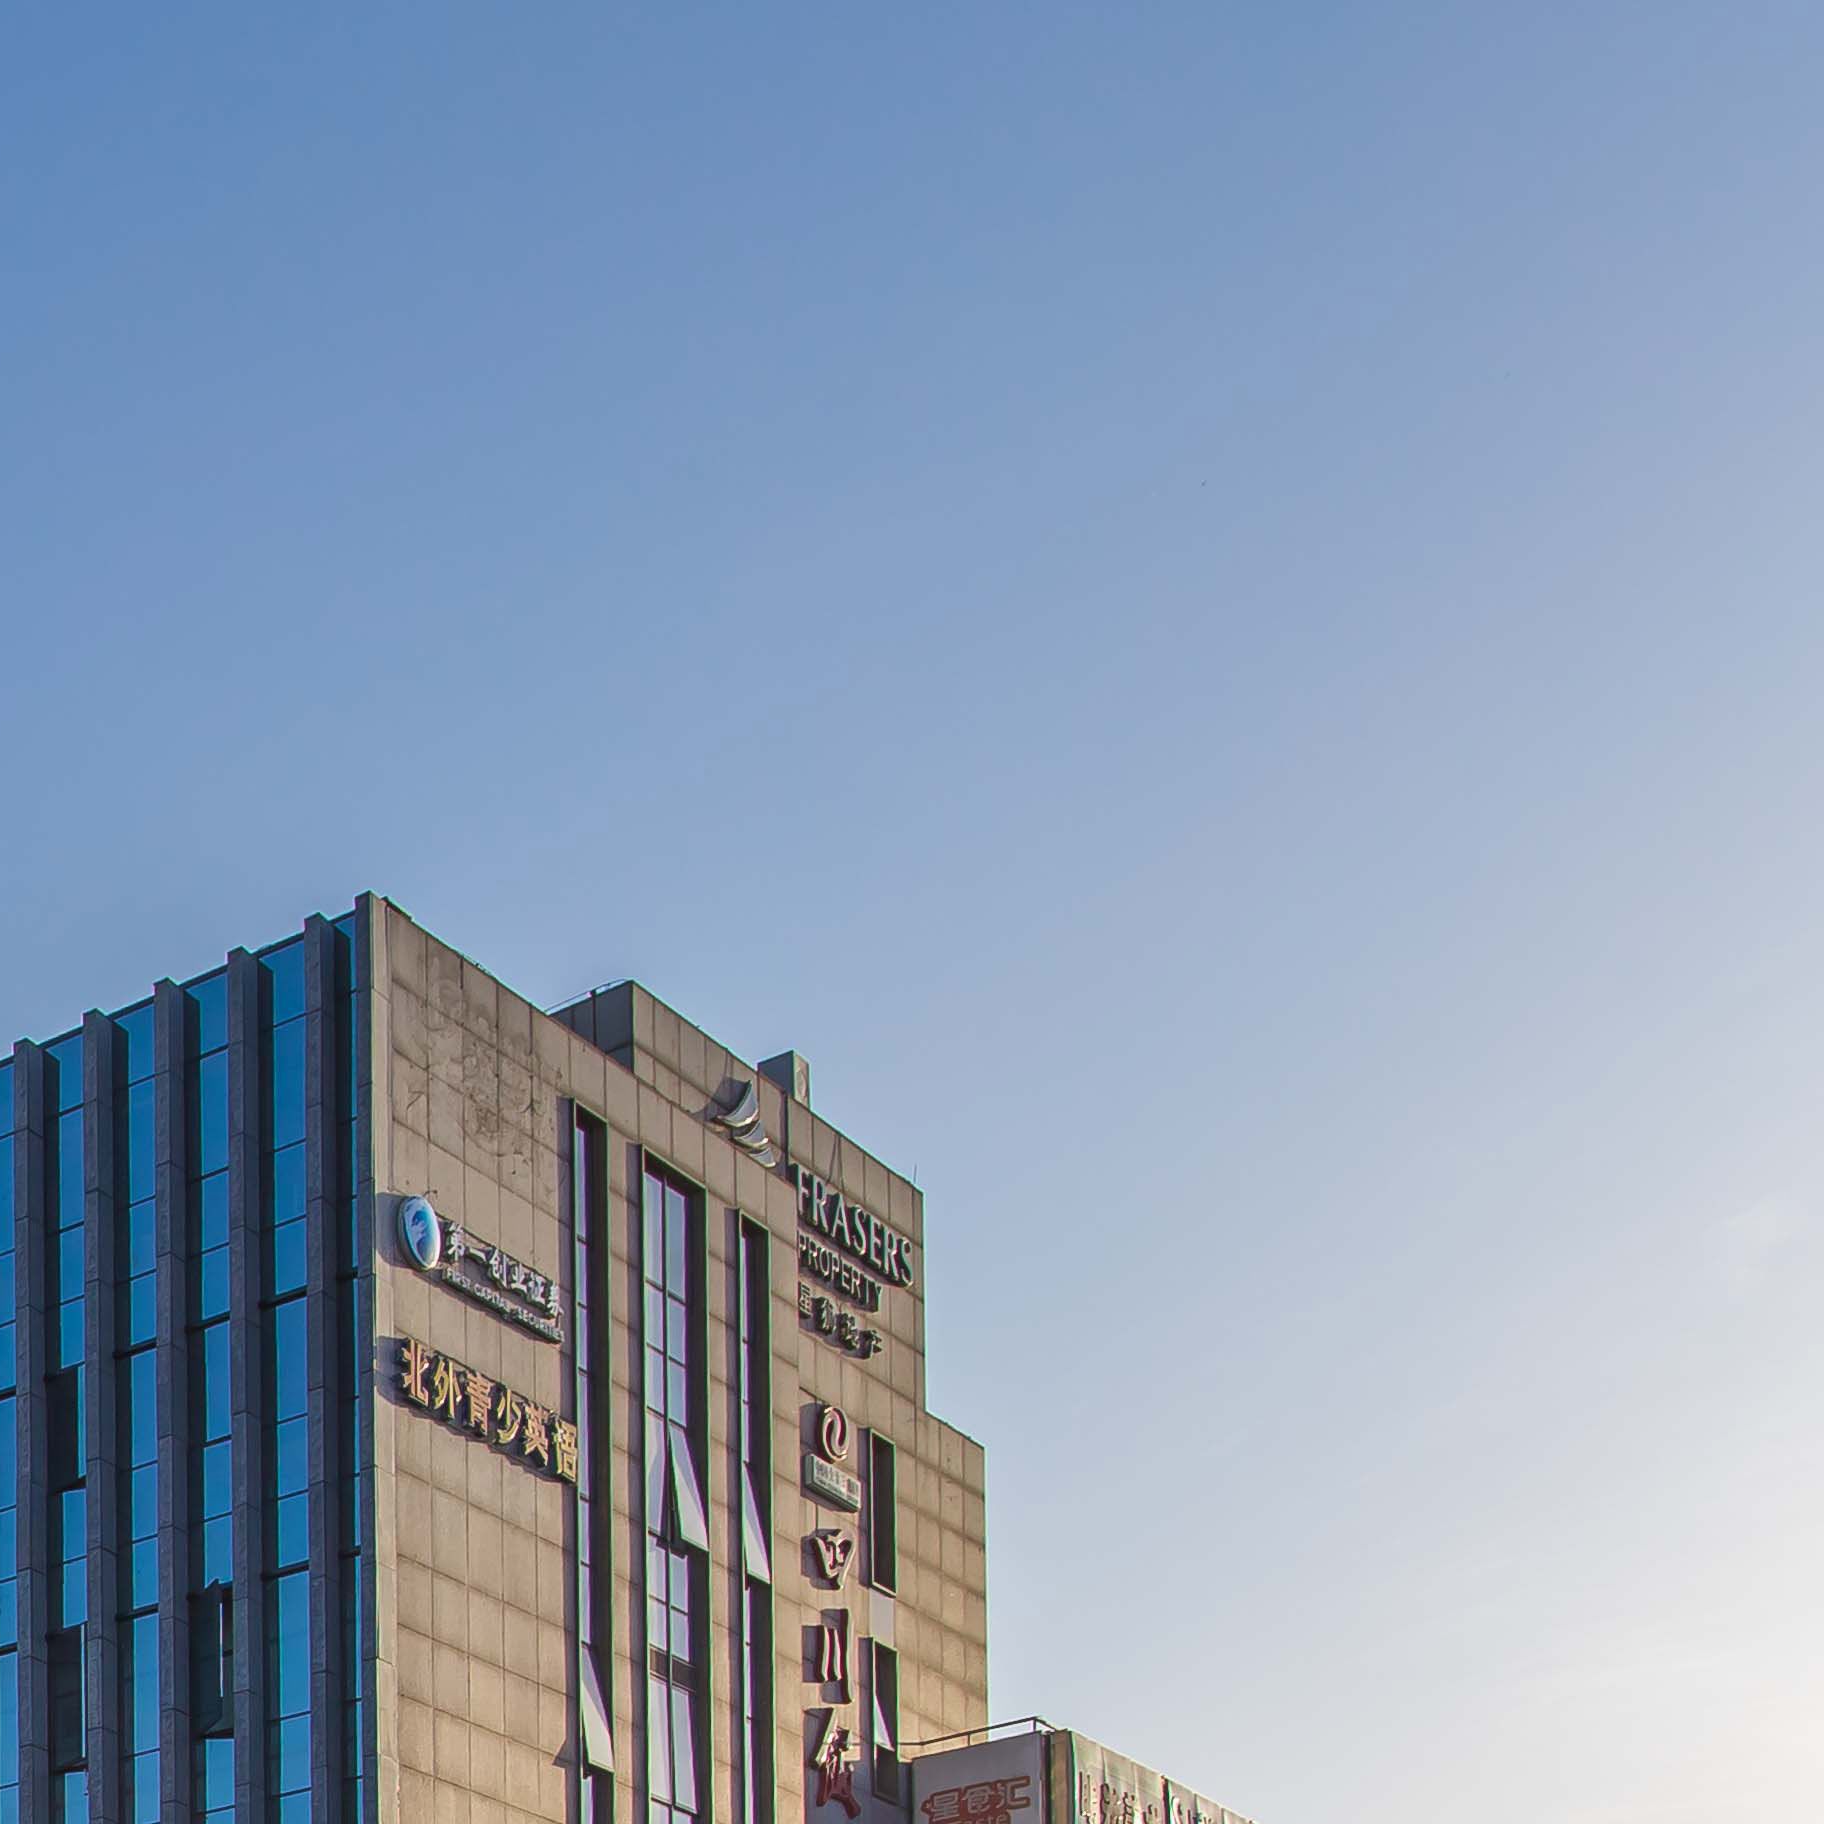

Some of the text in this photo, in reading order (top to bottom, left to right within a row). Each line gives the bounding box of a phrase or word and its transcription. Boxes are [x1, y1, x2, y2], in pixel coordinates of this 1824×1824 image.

[447, 1222, 564, 1322] 第一创业证券
[798, 1164, 914, 1288] FRASERS
[798, 1230, 883, 1312] PROPERTY
[403, 1339, 578, 1483] 北外青少英语
[923, 1777, 1030, 1824] 星食汇
